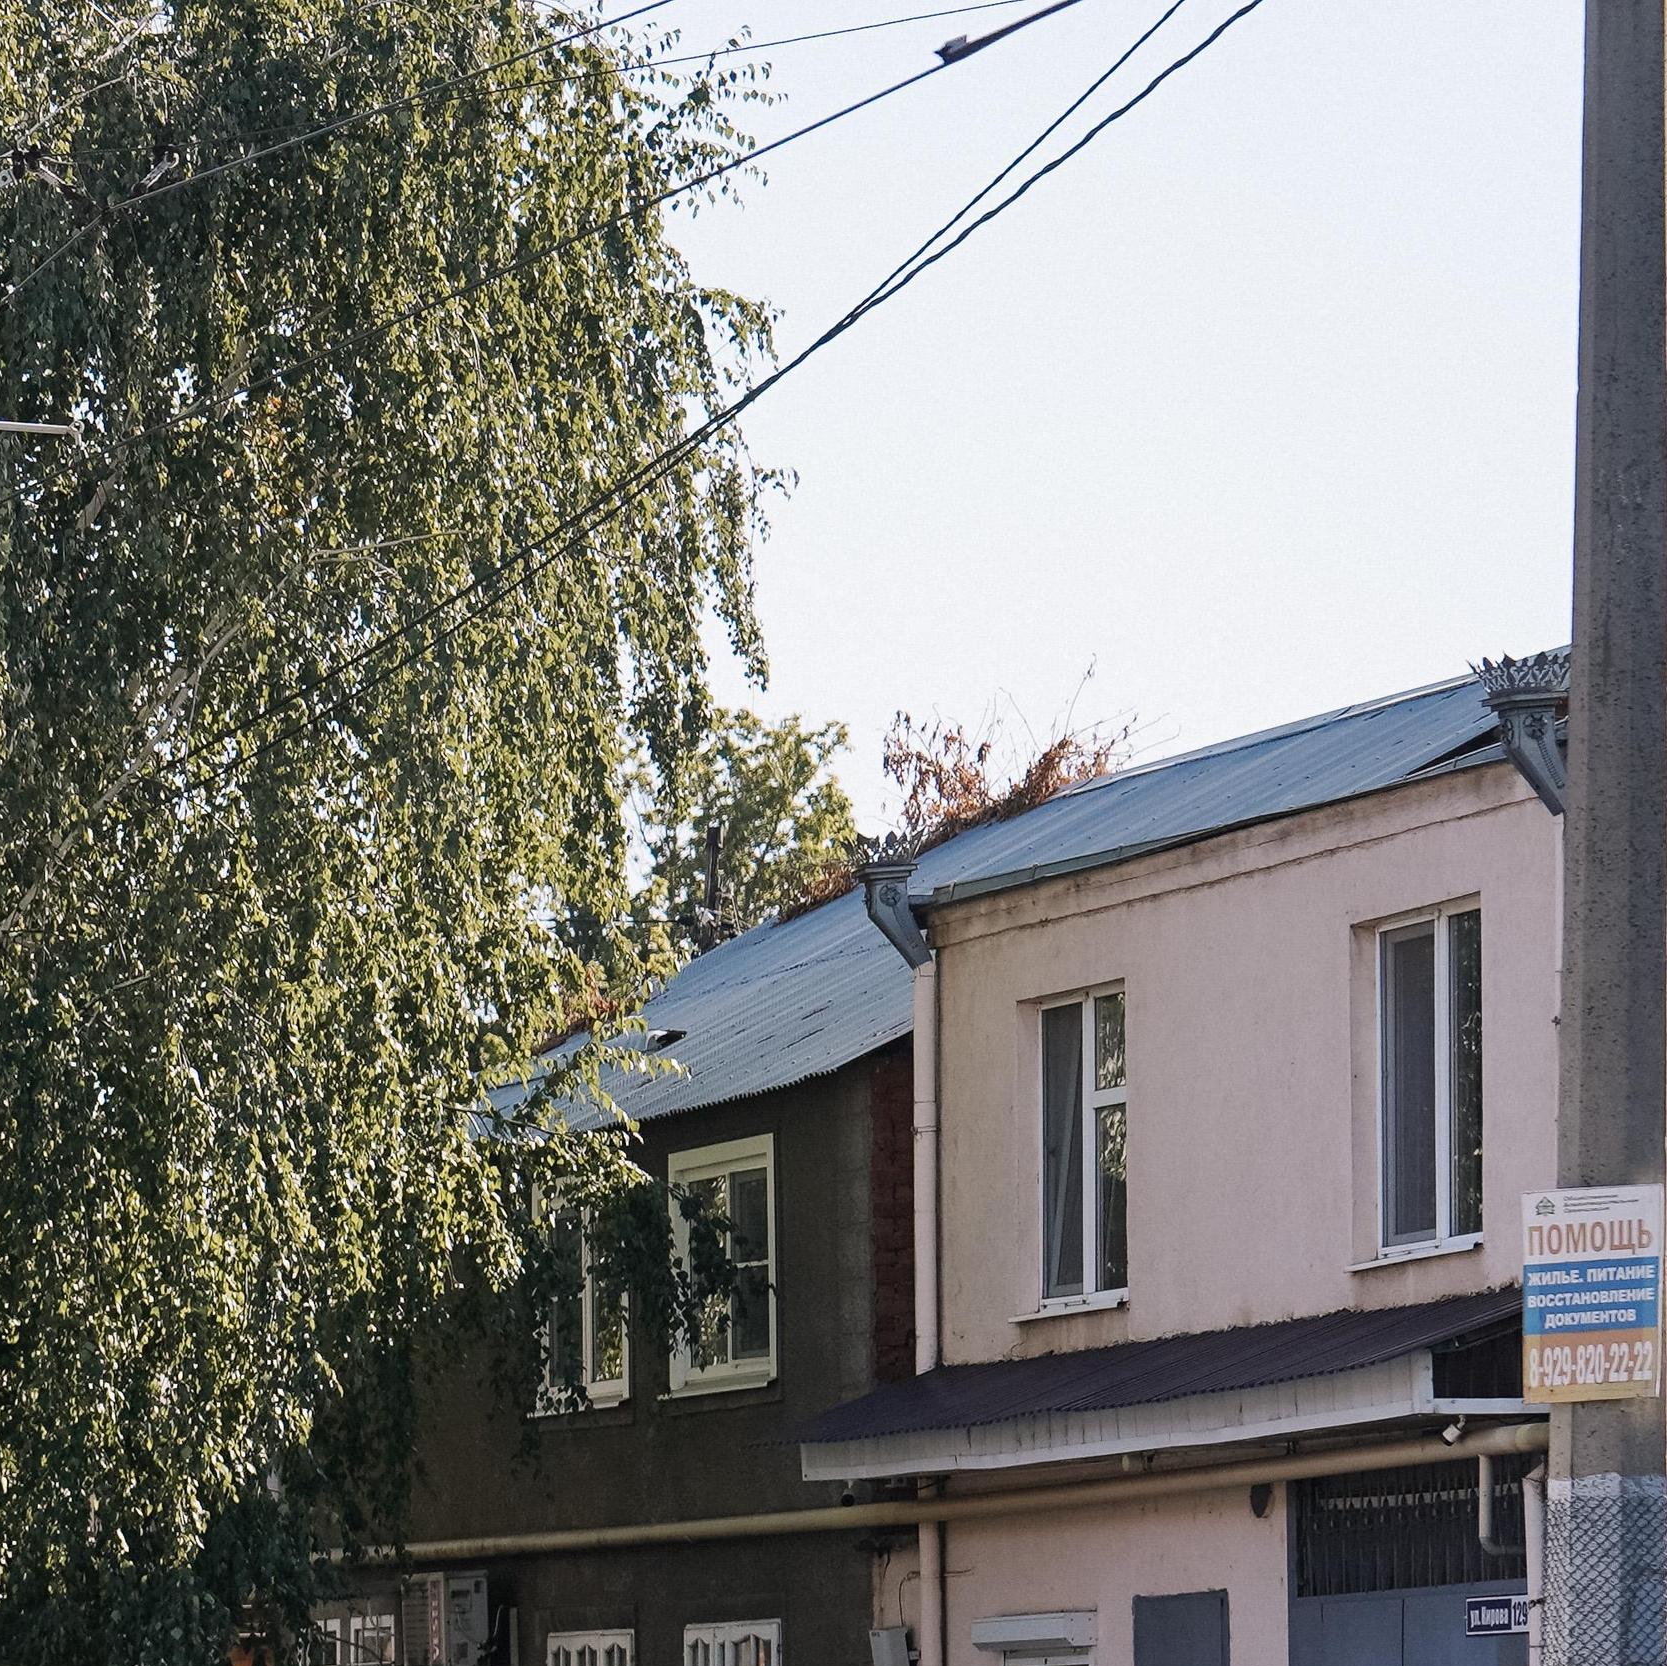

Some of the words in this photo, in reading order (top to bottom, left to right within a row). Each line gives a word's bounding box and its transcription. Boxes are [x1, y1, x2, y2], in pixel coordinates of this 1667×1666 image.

[1528, 1219, 1652, 1256] ПОМОЩЬ
[1527, 1269, 1584, 1287] ЖИЛЬЕ.
[1586, 1264, 1656, 1283] ПИТАНИЕ
[1527, 1287, 1656, 1309] ВОССТАНОВЛЕНИЕ
[1544, 1308, 1637, 1330] ДОКУМЕНТОВ
[1529, 1340, 1654, 1389] 8-929-820-22-22
[1512, 1601, 1528, 1627] 129
